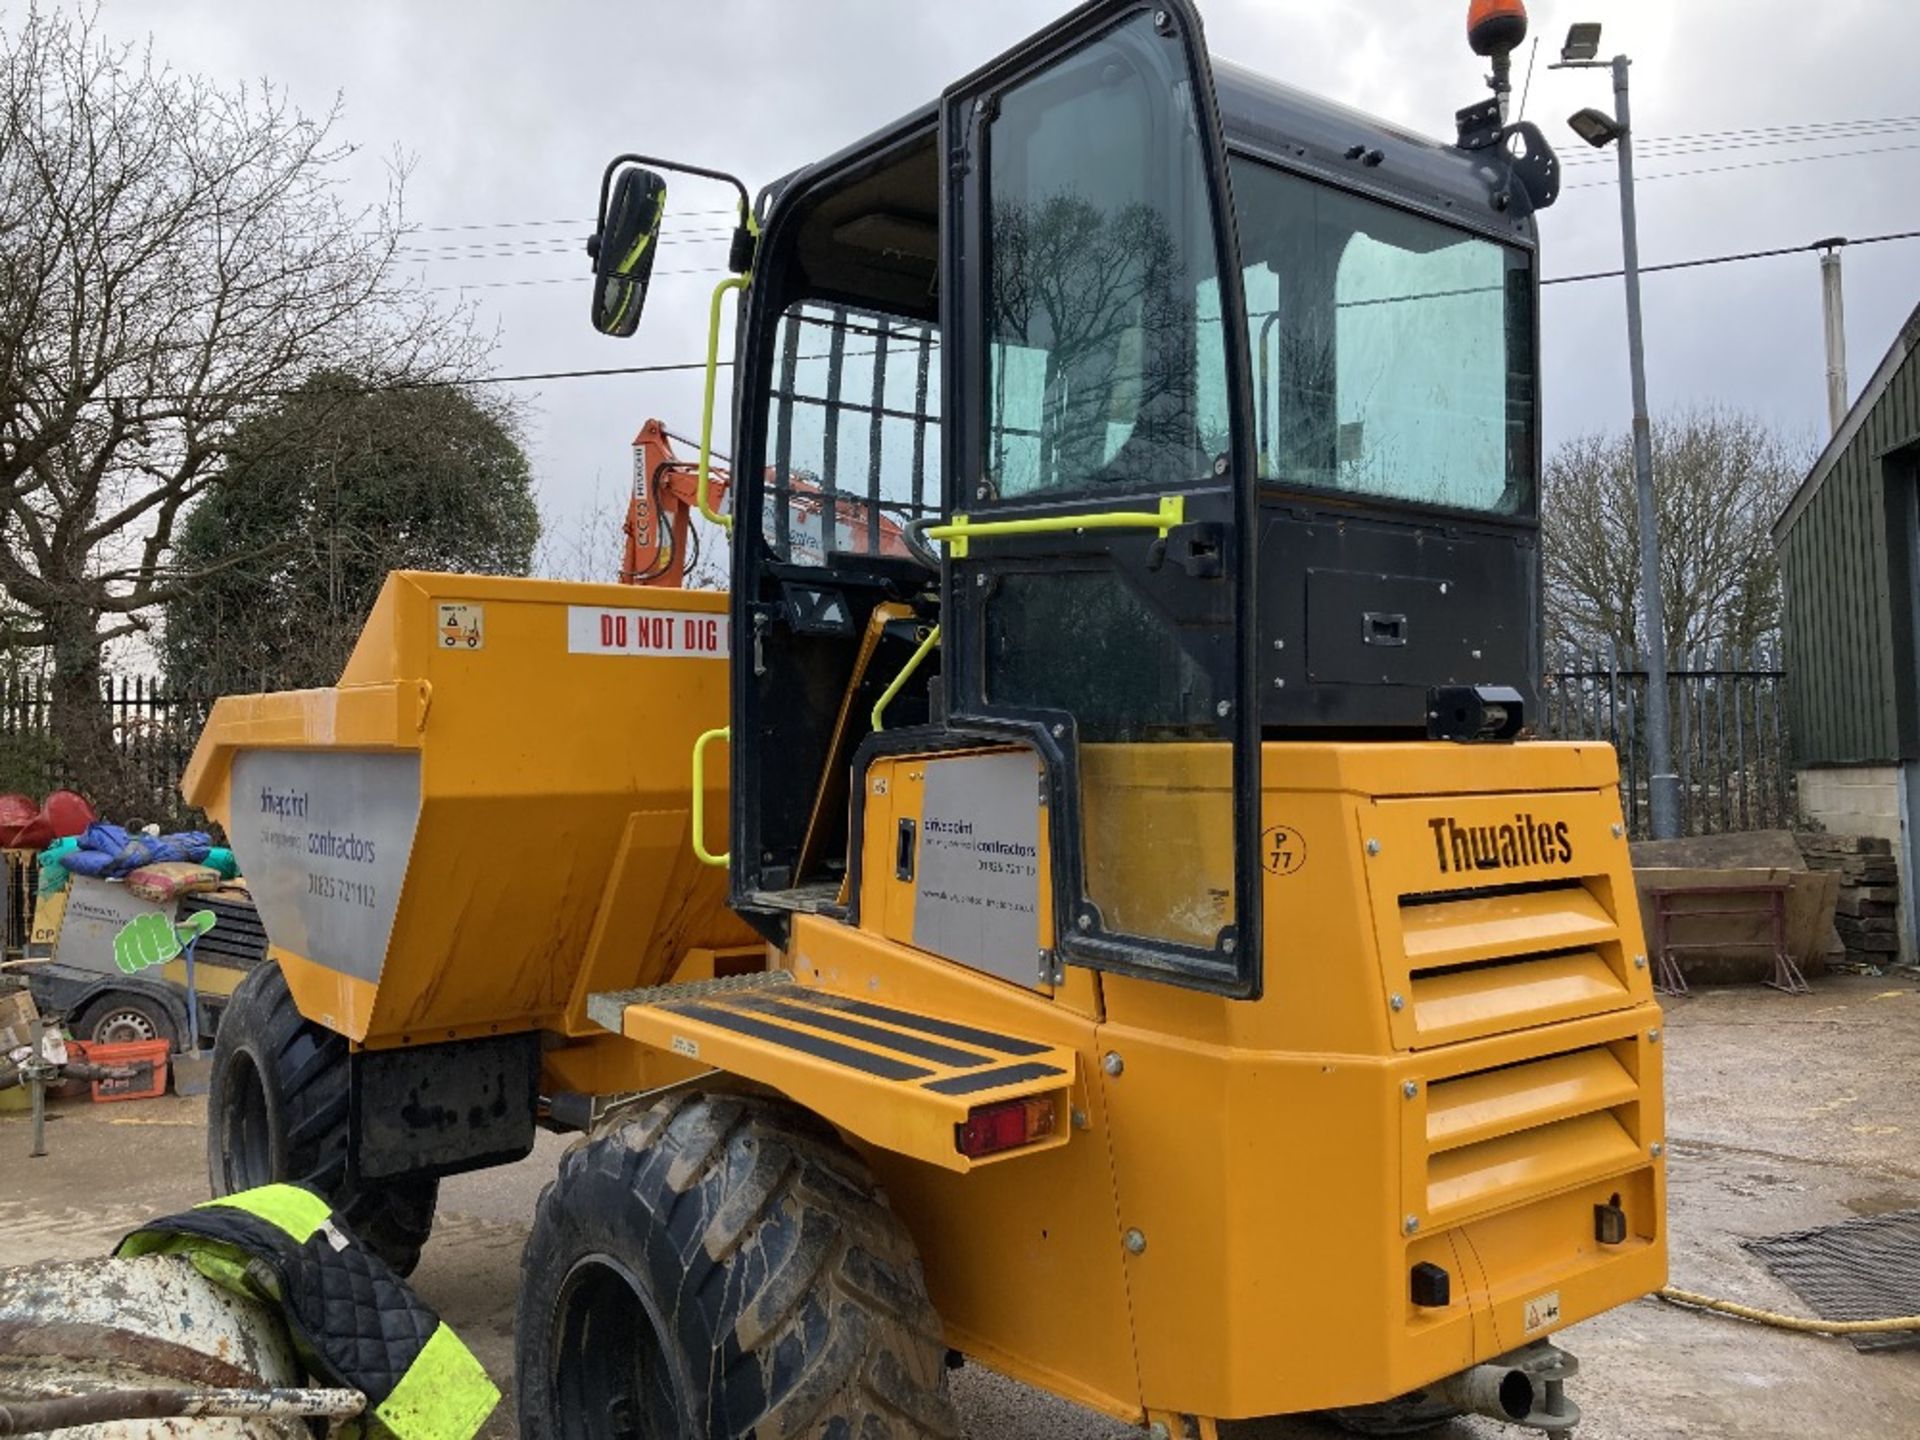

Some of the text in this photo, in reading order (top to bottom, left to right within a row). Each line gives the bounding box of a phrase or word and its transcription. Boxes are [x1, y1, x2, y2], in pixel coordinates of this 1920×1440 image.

[601, 614, 627, 648] DO
[639, 615, 675, 650] NOT
[685, 619, 717, 652] DIG
[308, 829, 376, 864] contractors
[977, 840, 1036, 857] contractors
[1275, 832, 1287, 849] P
[1428, 813, 1573, 874] Thwaites
[1270, 851, 1292, 869] 77
[36, 928, 55, 941] CP
